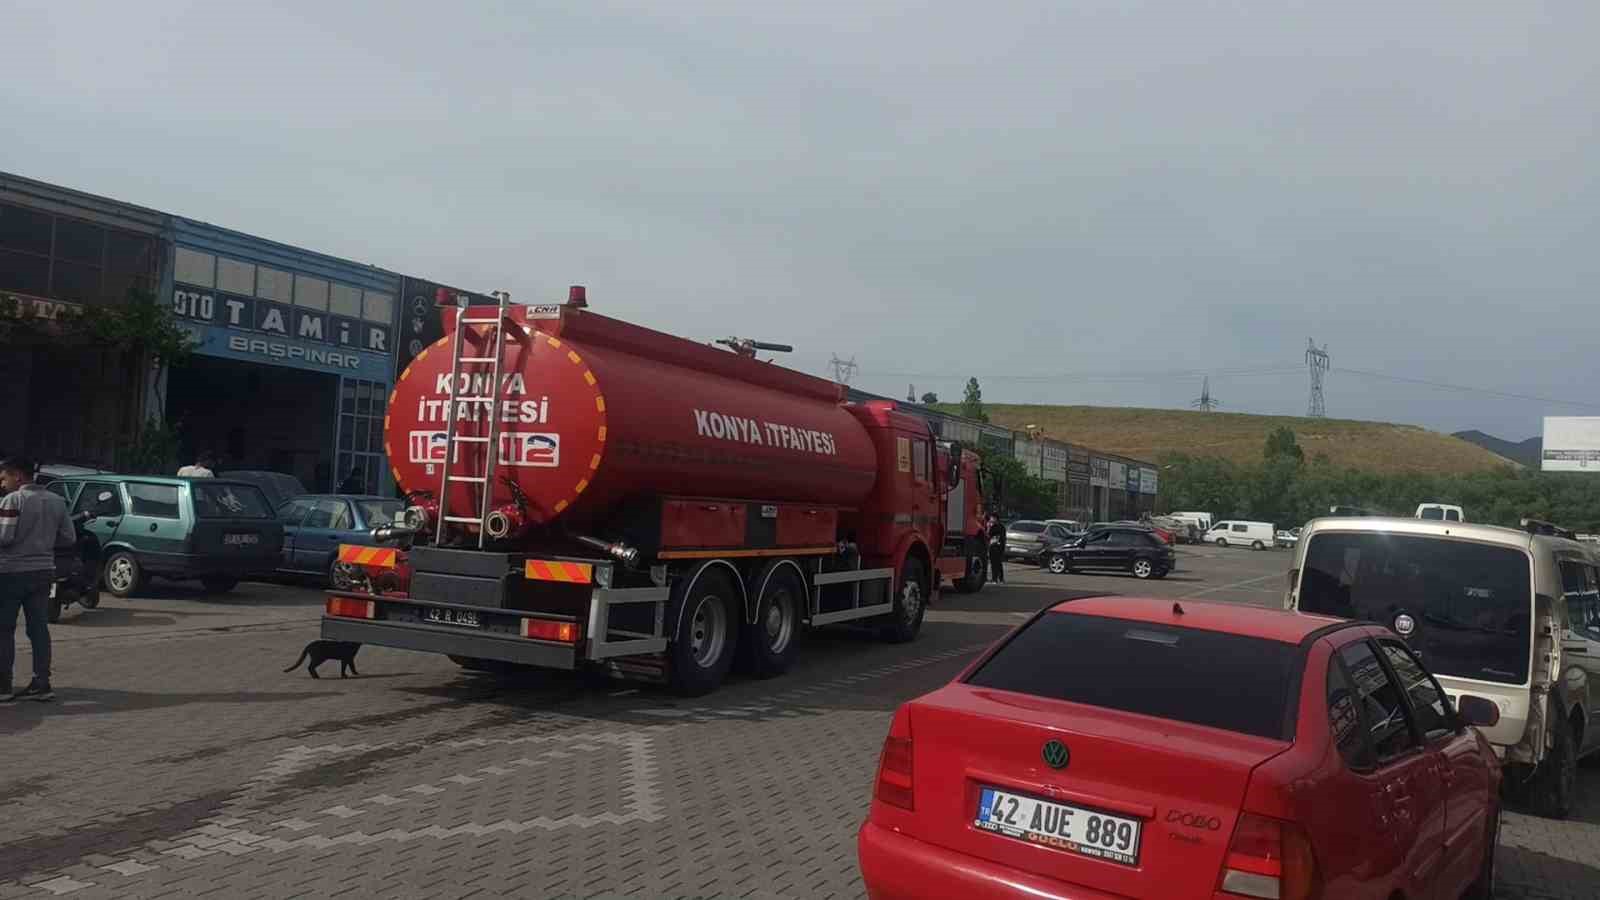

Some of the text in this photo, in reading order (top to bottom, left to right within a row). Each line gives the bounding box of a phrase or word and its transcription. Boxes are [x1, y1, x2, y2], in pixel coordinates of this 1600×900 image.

[173, 289, 214, 320] OTO
[693, 409, 763, 445] KONYA
[992, 795, 1132, 851] 42 AUE 889
